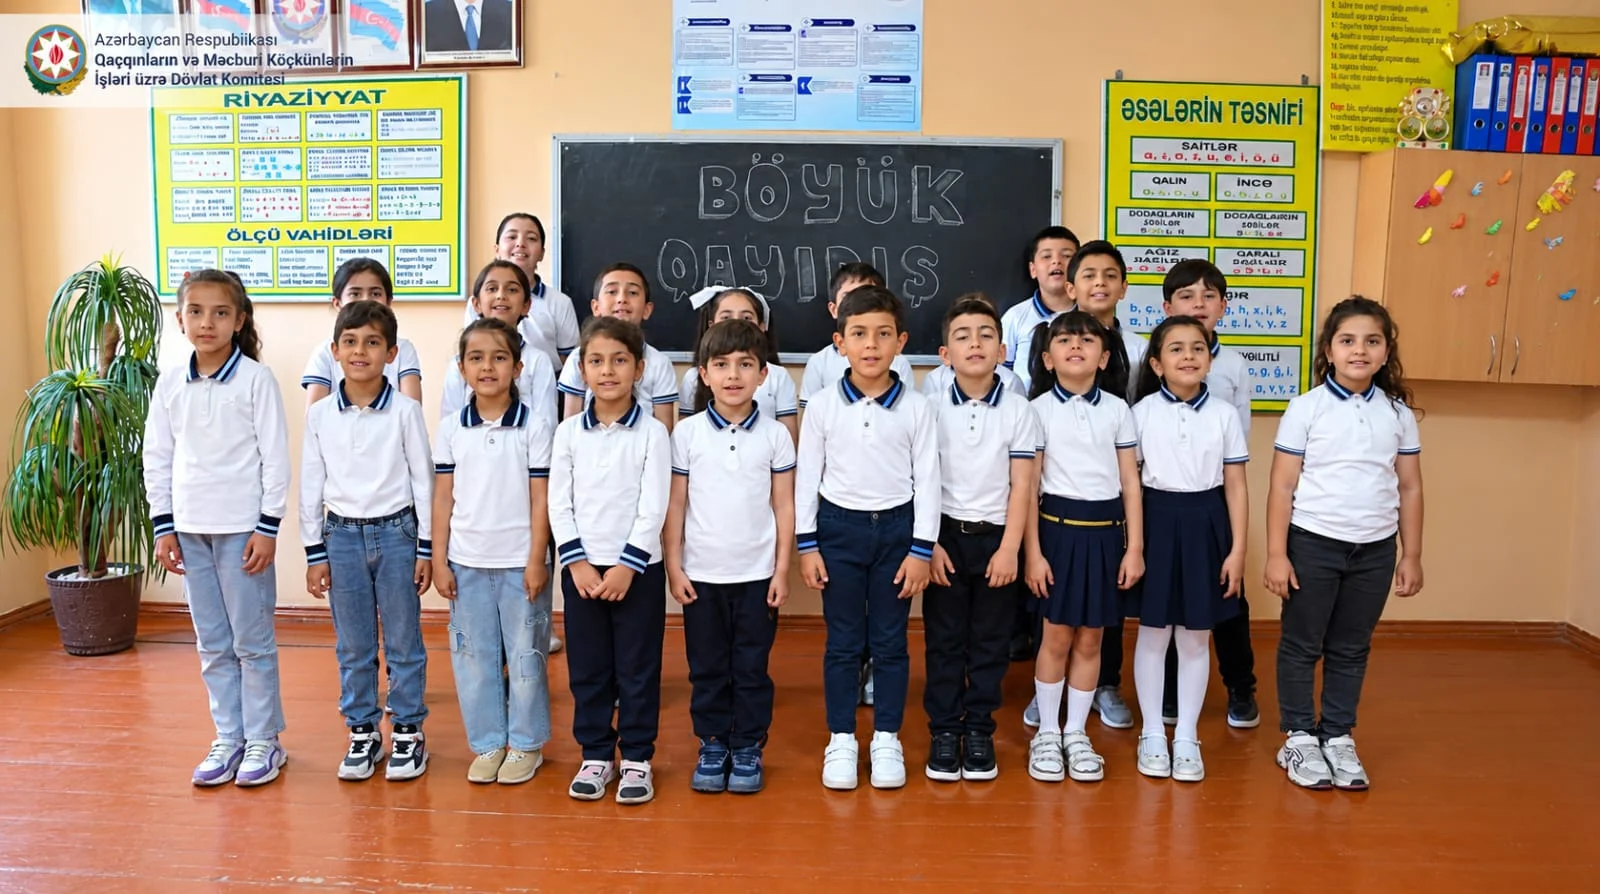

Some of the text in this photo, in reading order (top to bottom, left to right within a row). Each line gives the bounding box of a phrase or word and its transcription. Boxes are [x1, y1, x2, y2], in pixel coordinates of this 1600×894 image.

[223, 88, 387, 107] RİYAZİYYAT
[1121, 95, 1223, 124] ƏSƏLƏRİN
[1229, 97, 1303, 126] TƏSNİFİ
[1182, 141, 1238, 152] SAİTLƏR
[699, 153, 964, 225] BÖYÜK
[1152, 176, 1187, 186] QALIN
[226, 226, 393, 244] ÖLÇÜ VAHİDLƏRİ
